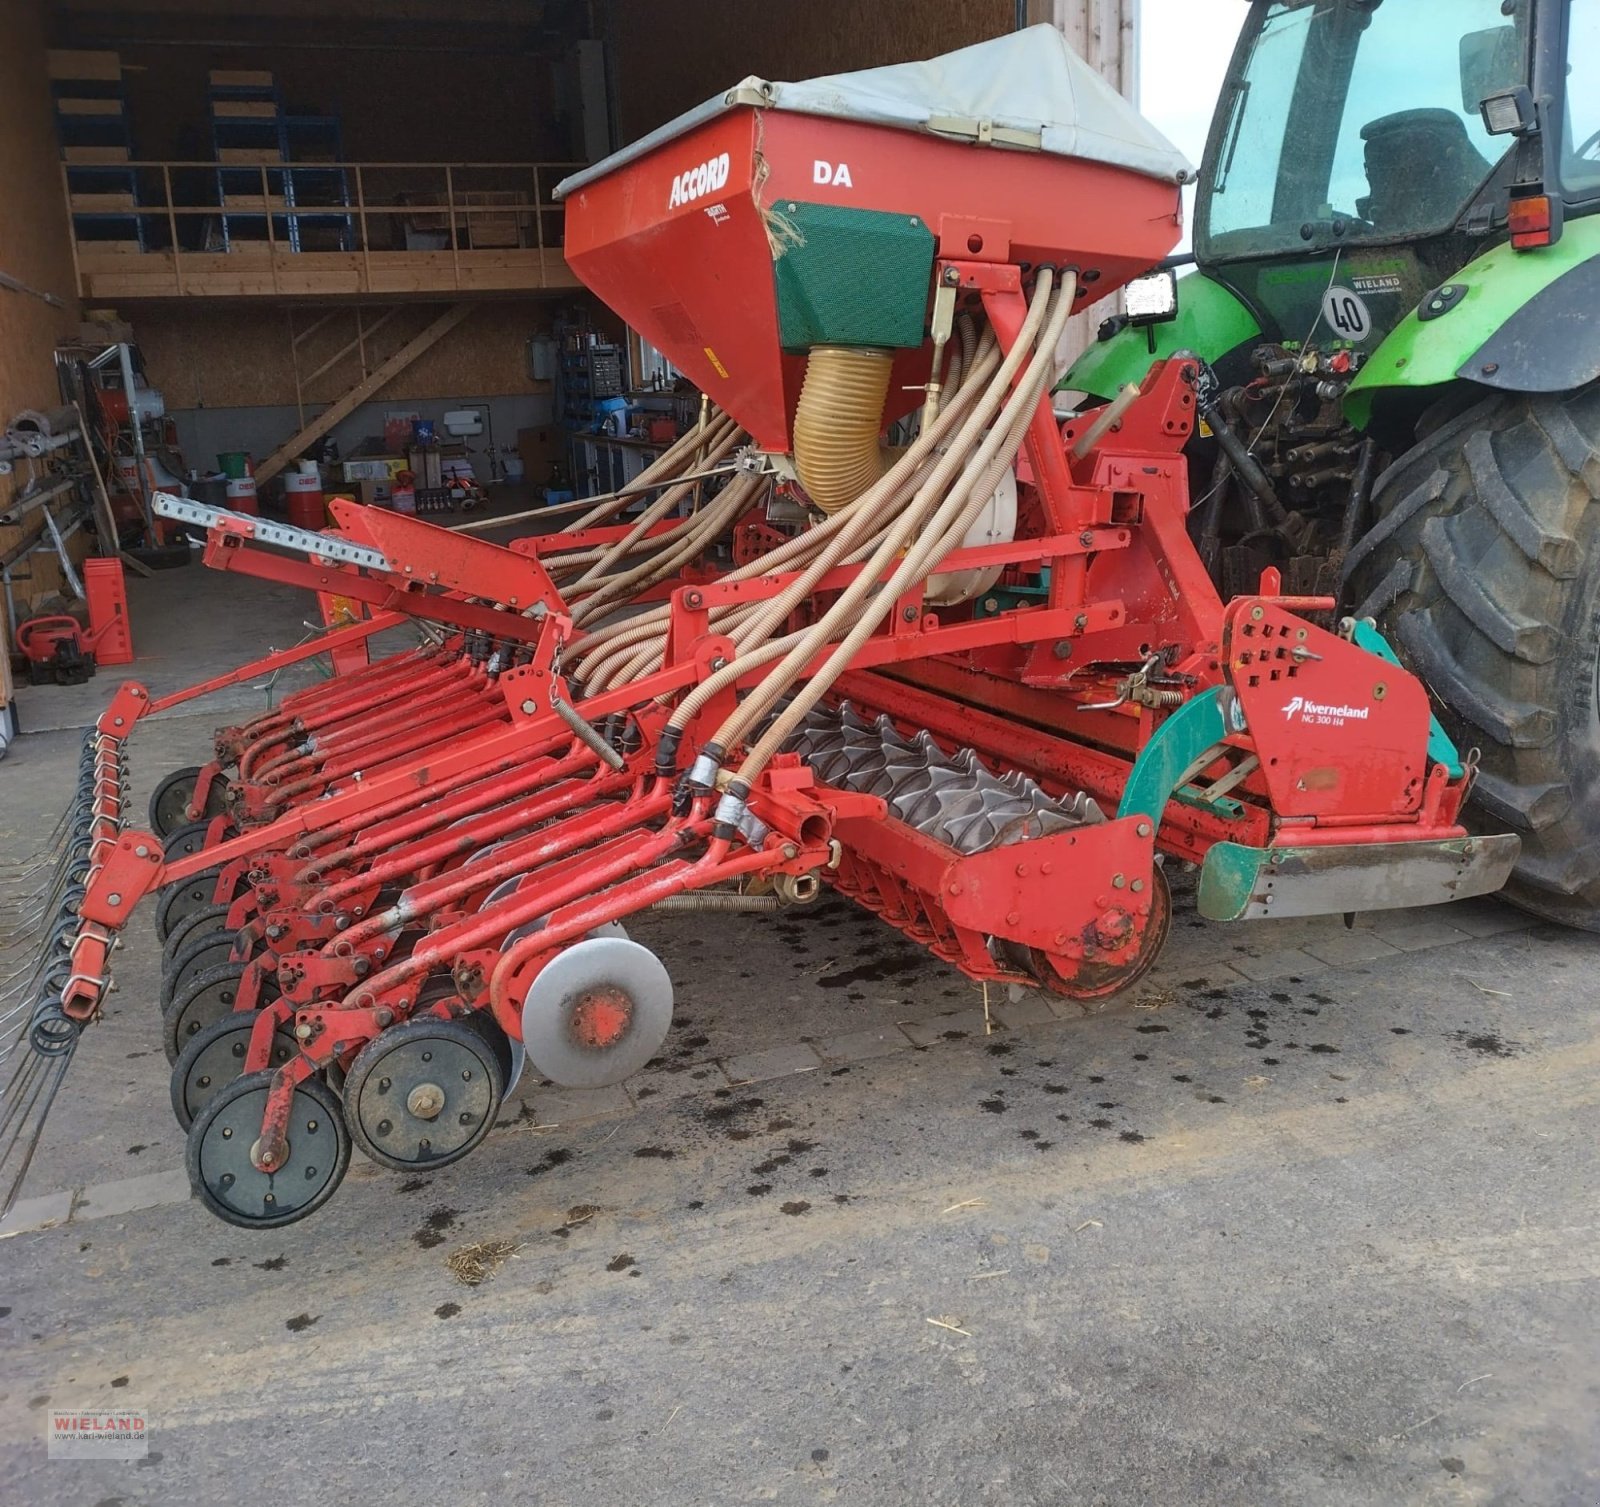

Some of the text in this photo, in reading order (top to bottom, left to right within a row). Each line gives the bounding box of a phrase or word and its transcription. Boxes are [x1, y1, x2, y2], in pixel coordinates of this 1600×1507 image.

[669, 153, 730, 210] ACCORD
[813, 160, 853, 188] DA
[1353, 278, 1400, 289] WIELAND
[1331, 297, 1364, 333] 40
[1301, 714, 1314, 724] NG
[1316, 715, 1331, 725] 300
[1304, 701, 1369, 719] Kverneland
